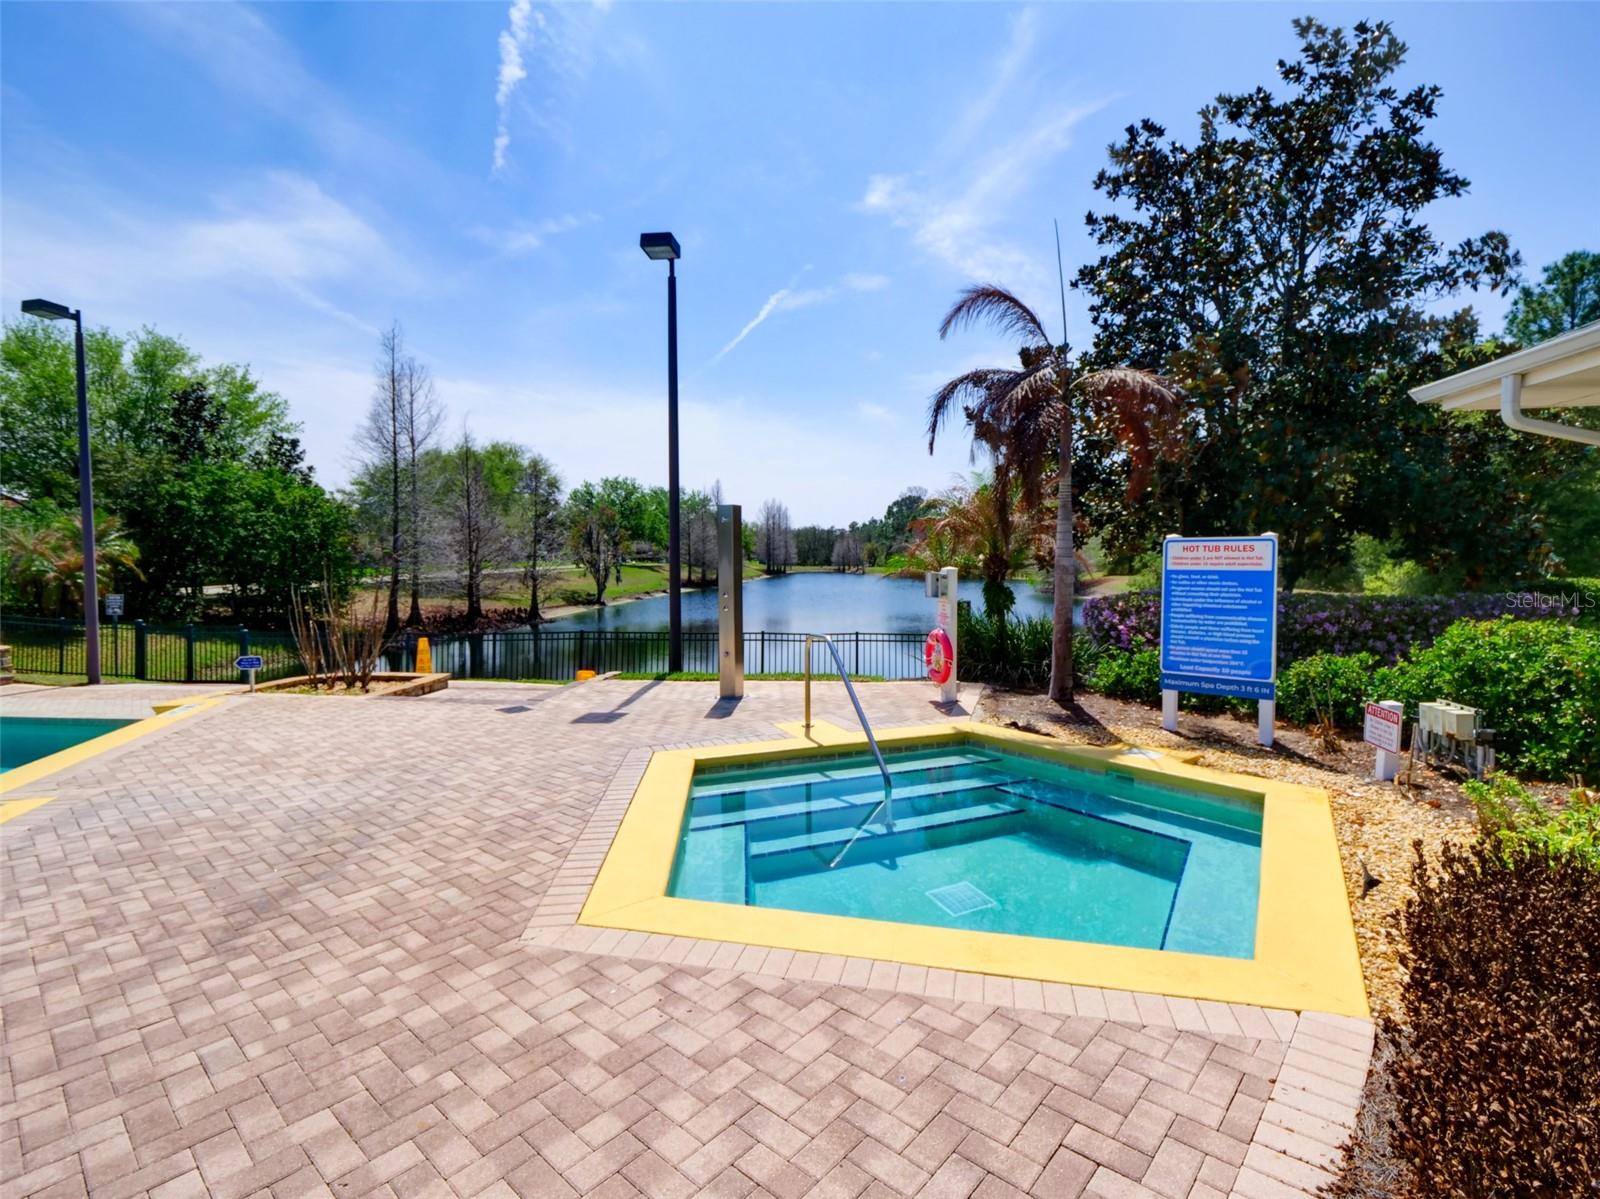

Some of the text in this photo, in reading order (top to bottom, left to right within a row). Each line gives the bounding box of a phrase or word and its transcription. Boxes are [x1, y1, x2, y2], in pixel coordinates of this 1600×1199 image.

[1183, 544, 1255, 553] HOT TUB RULES
[1164, 678, 1200, 687] Maximum
[1201, 681, 1215, 689] Spa
[1216, 683, 1239, 692] Depth
[1368, 704, 1399, 724] ATTENTION
